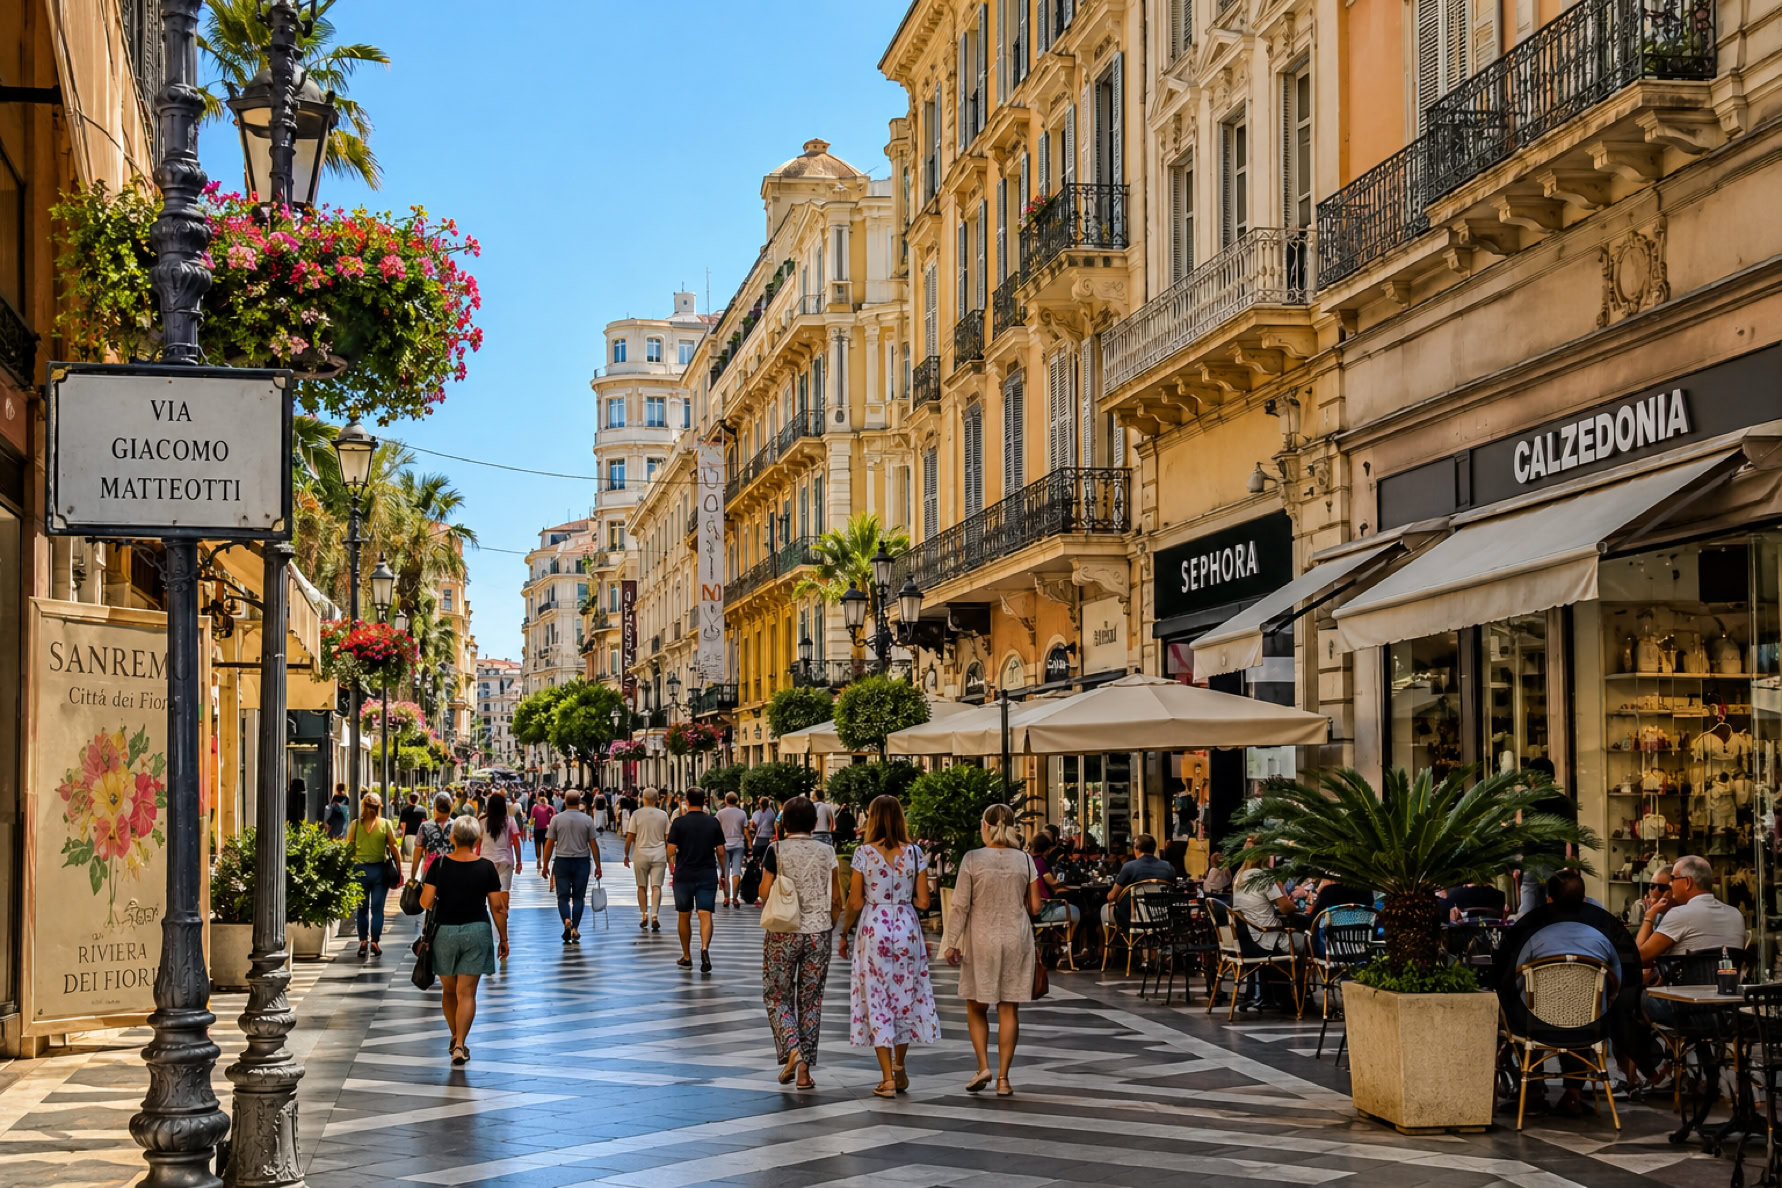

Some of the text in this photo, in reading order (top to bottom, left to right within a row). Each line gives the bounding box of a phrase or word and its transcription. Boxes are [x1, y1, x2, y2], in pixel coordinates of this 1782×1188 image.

[150, 399, 192, 422] VIA
[1513, 388, 1690, 484] CALZEDONIA
[111, 437, 229, 462] GIACOMO
[100, 477, 241, 501] MATTEOTTI
[1181, 540, 1260, 594] SEPHORA
[49, 641, 168, 681] SANREM
[112, 690, 134, 708] dei
[139, 692, 168, 711] Fior
[78, 942, 147, 964] RIVIERA
[63, 967, 156, 995] DEI FIORI
